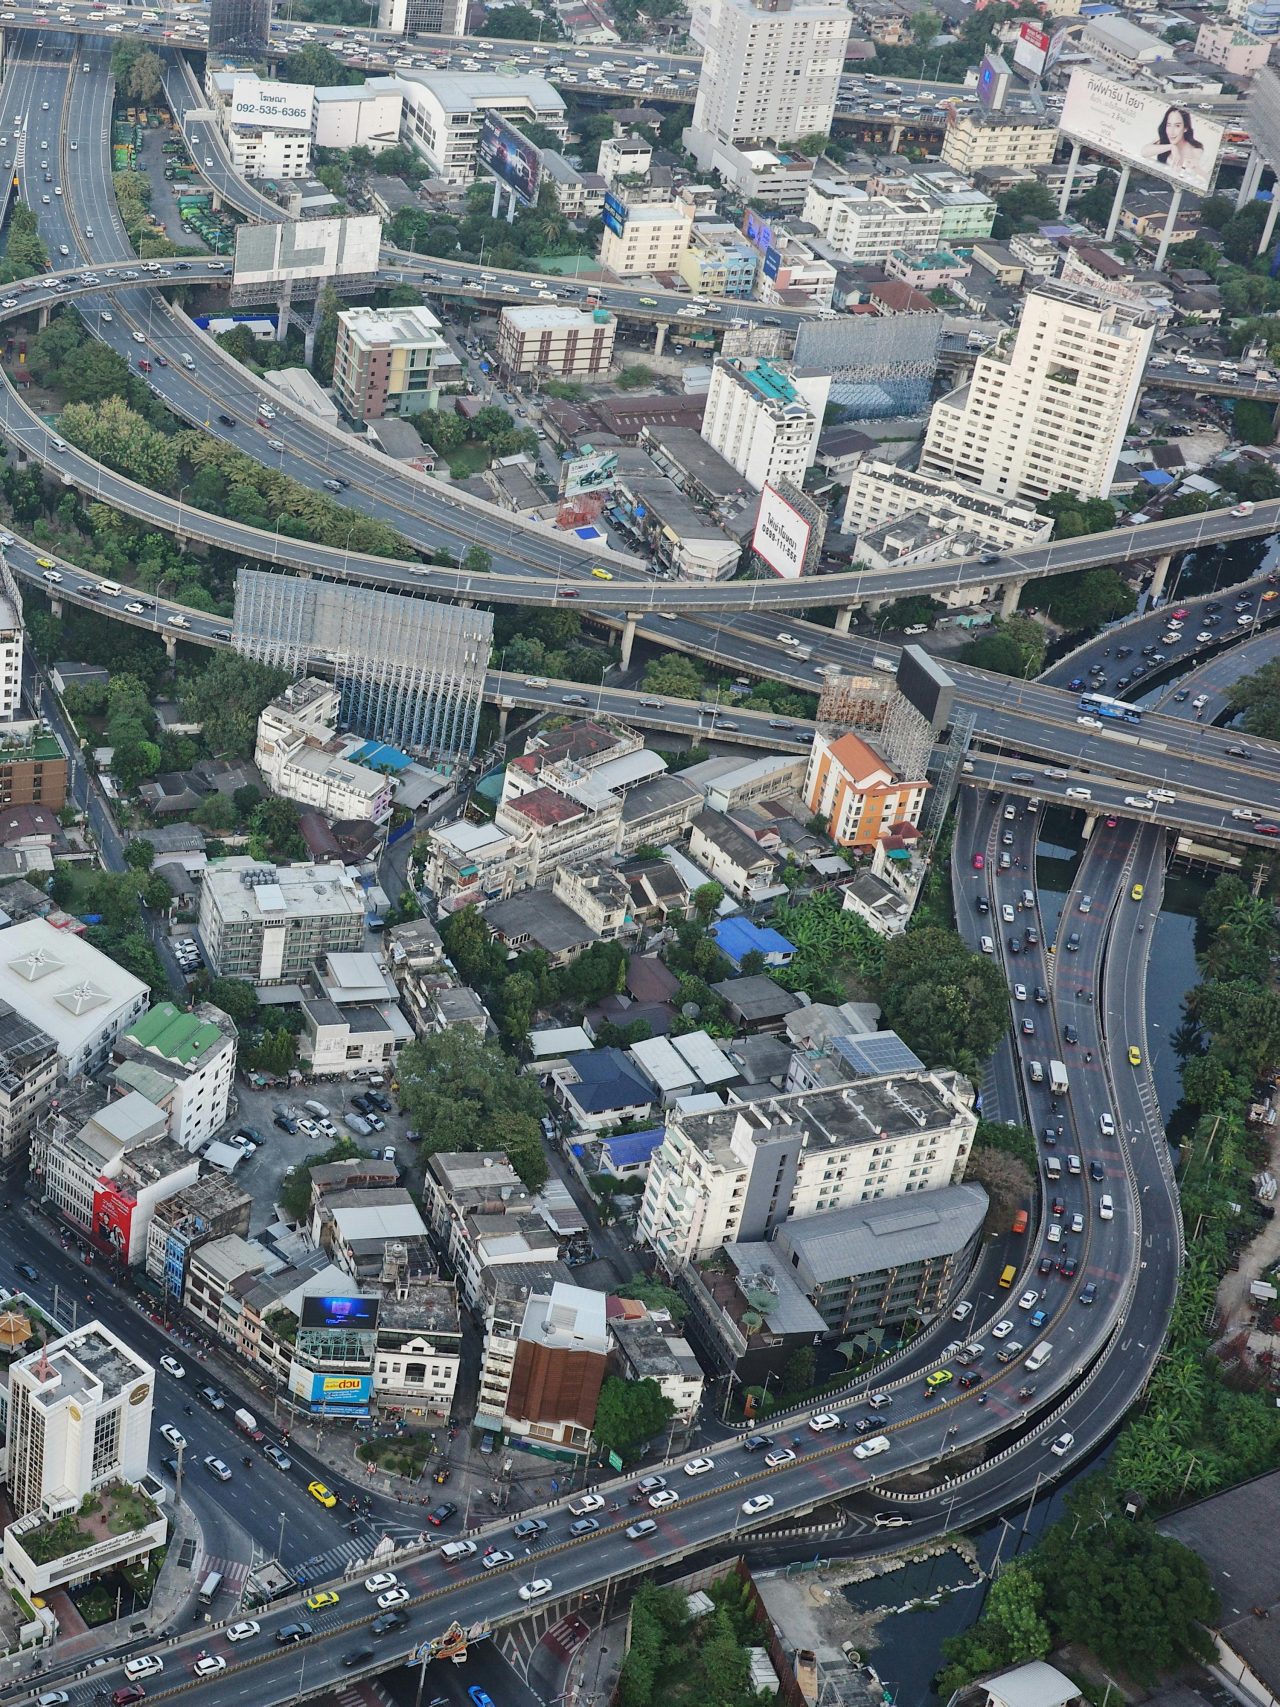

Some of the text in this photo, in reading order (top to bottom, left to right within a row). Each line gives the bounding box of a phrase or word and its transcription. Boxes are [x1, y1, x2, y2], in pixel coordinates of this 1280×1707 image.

[259, 91, 287, 103] โฆษณา
[1086, 79, 1124, 103] กิฟฟารีน
[236, 103, 307, 118] 092-535-6365
